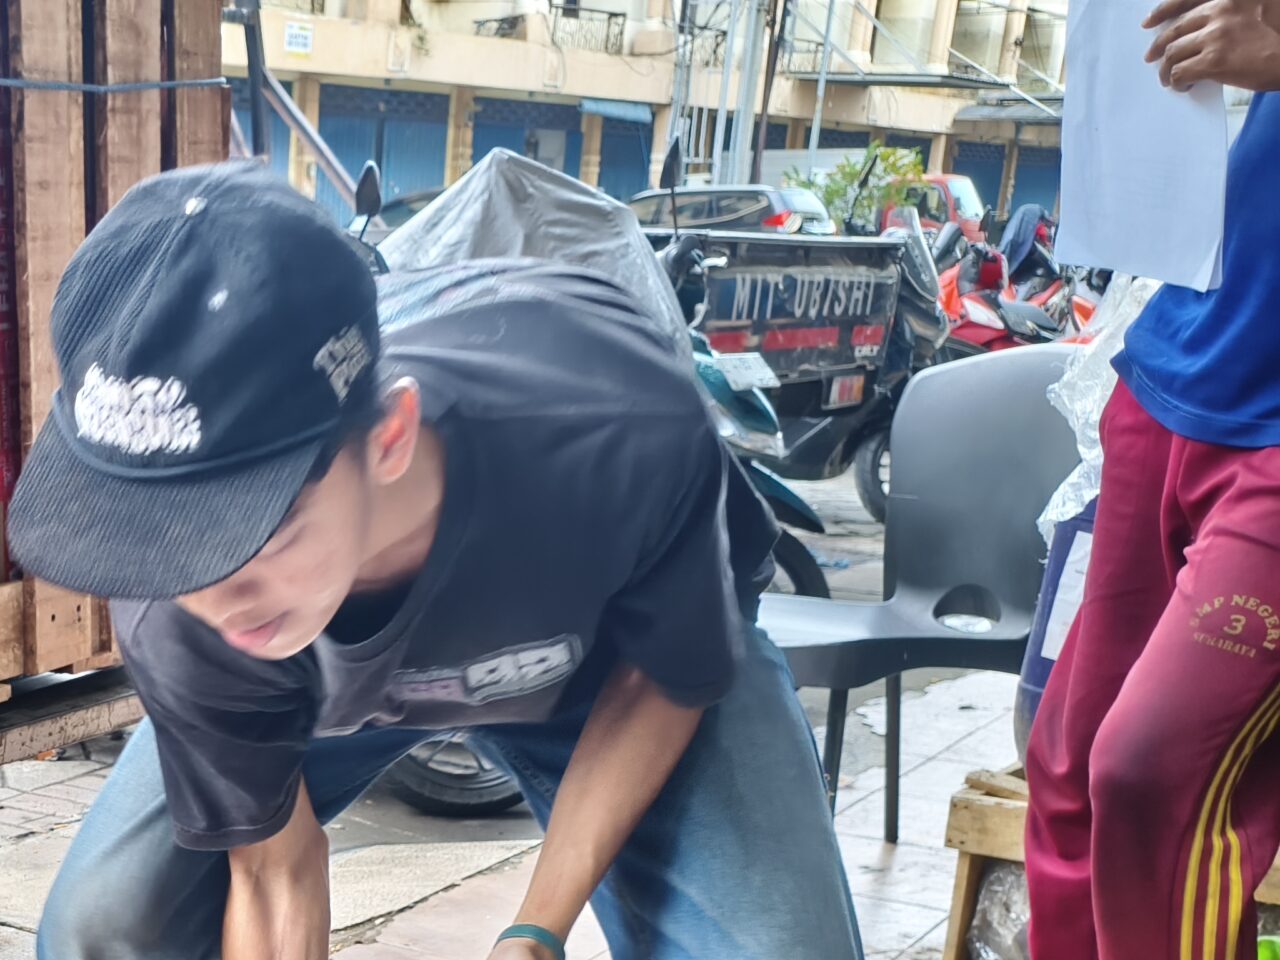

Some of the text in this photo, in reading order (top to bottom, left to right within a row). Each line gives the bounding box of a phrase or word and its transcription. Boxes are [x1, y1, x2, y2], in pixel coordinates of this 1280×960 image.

[732, 272, 875, 321] MITUBISHI
[1223, 614, 1247, 636] 3
[1230, 594, 1280, 650] NEGERI
